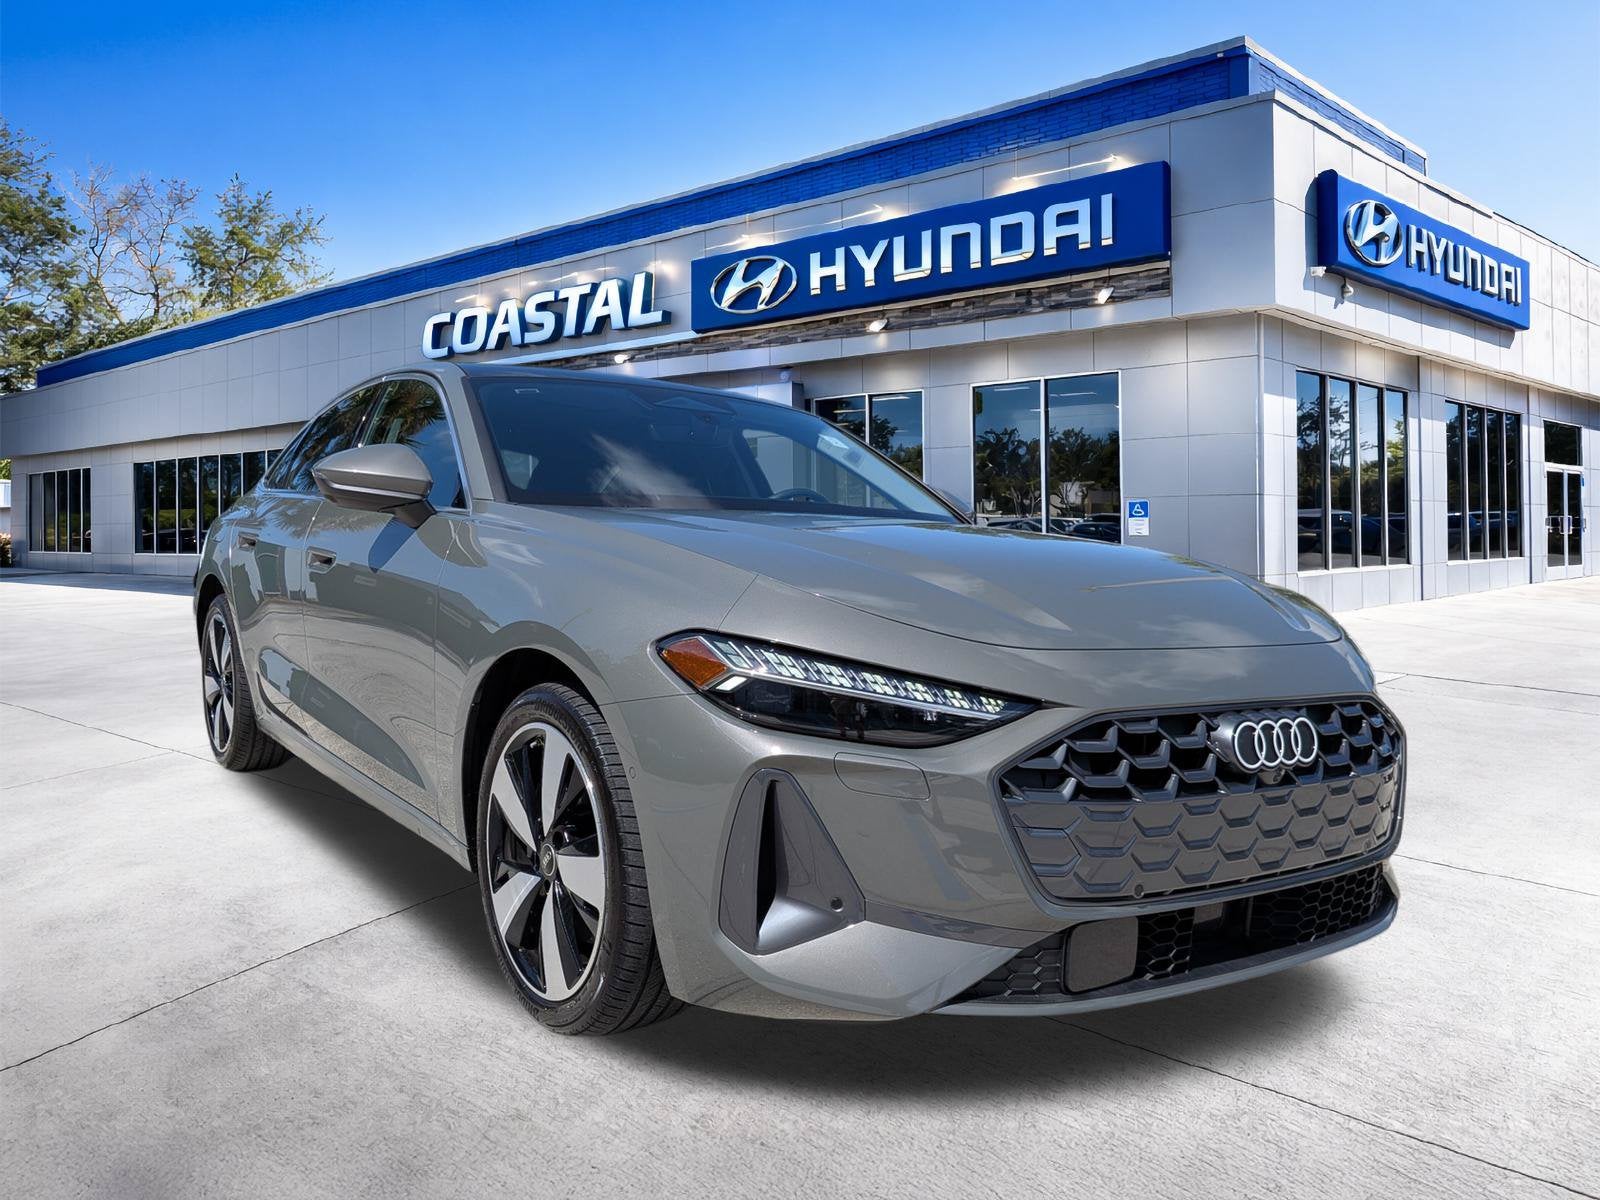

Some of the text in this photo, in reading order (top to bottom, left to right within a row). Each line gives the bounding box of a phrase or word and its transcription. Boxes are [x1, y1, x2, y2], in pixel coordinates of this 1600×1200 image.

[810, 193, 1113, 295] HYUNDAI
[1407, 224, 1521, 305] HYUNDAI
[422, 271, 666, 359] COASTAL
